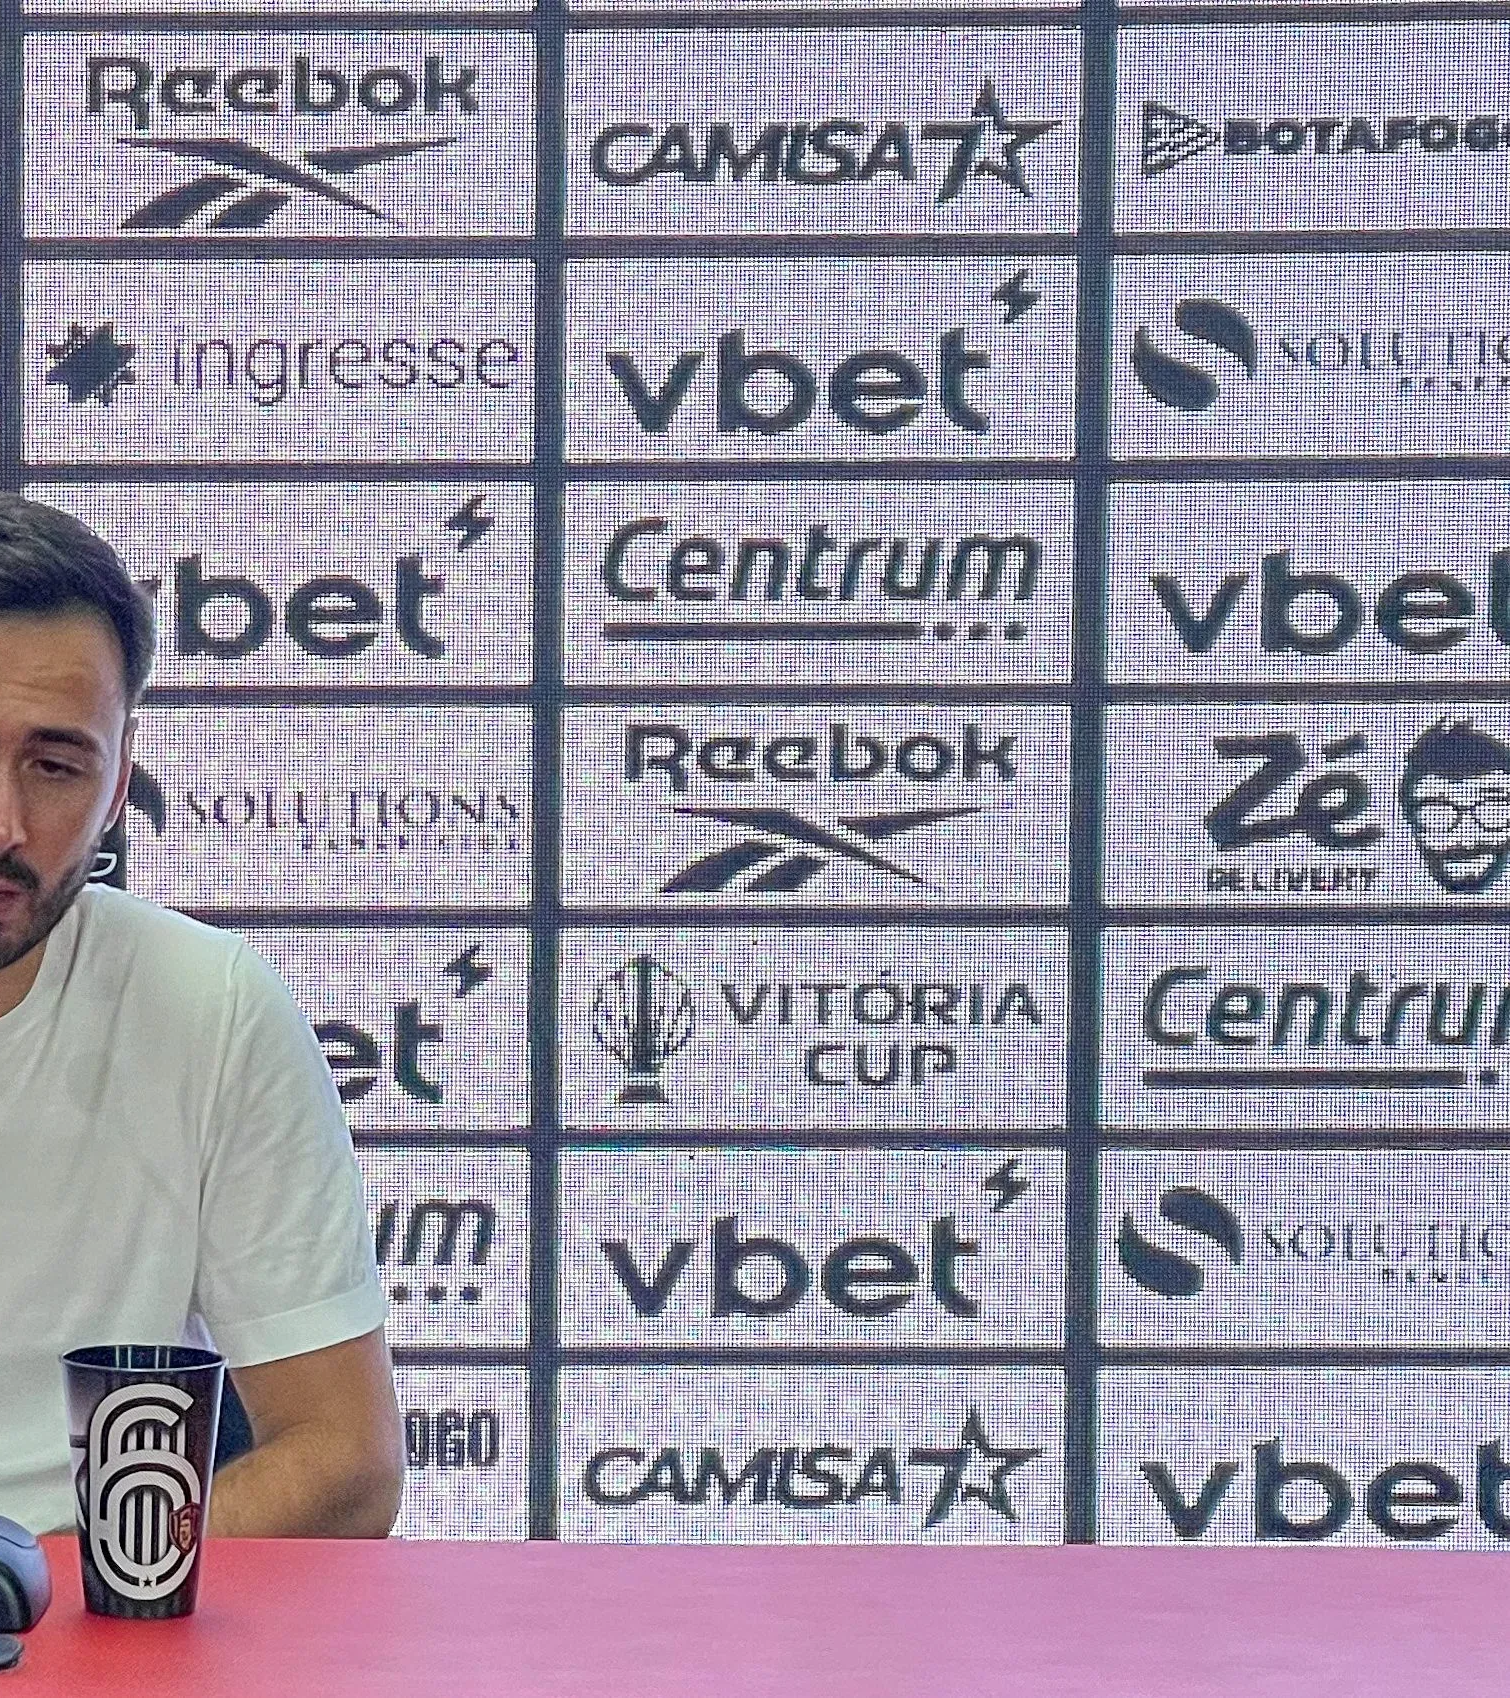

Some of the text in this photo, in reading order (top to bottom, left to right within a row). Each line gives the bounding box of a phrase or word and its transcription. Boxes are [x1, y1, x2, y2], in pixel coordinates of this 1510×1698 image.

[85, 56, 479, 130] Reebok
[1224, 115, 1510, 154] BOTAFOG
[172, 325, 520, 406] ingresse
[607, 328, 990, 435] vbet
[603, 516, 1042, 601] Centrum
[625, 723, 1017, 792] Reebok
[1204, 731, 1385, 851] Zé
[721, 970, 1041, 1025] VITÓRIA
[1144, 965, 1510, 1046] Centru
[805, 1043, 957, 1087] CUP
[600, 1217, 981, 1317] vbet
